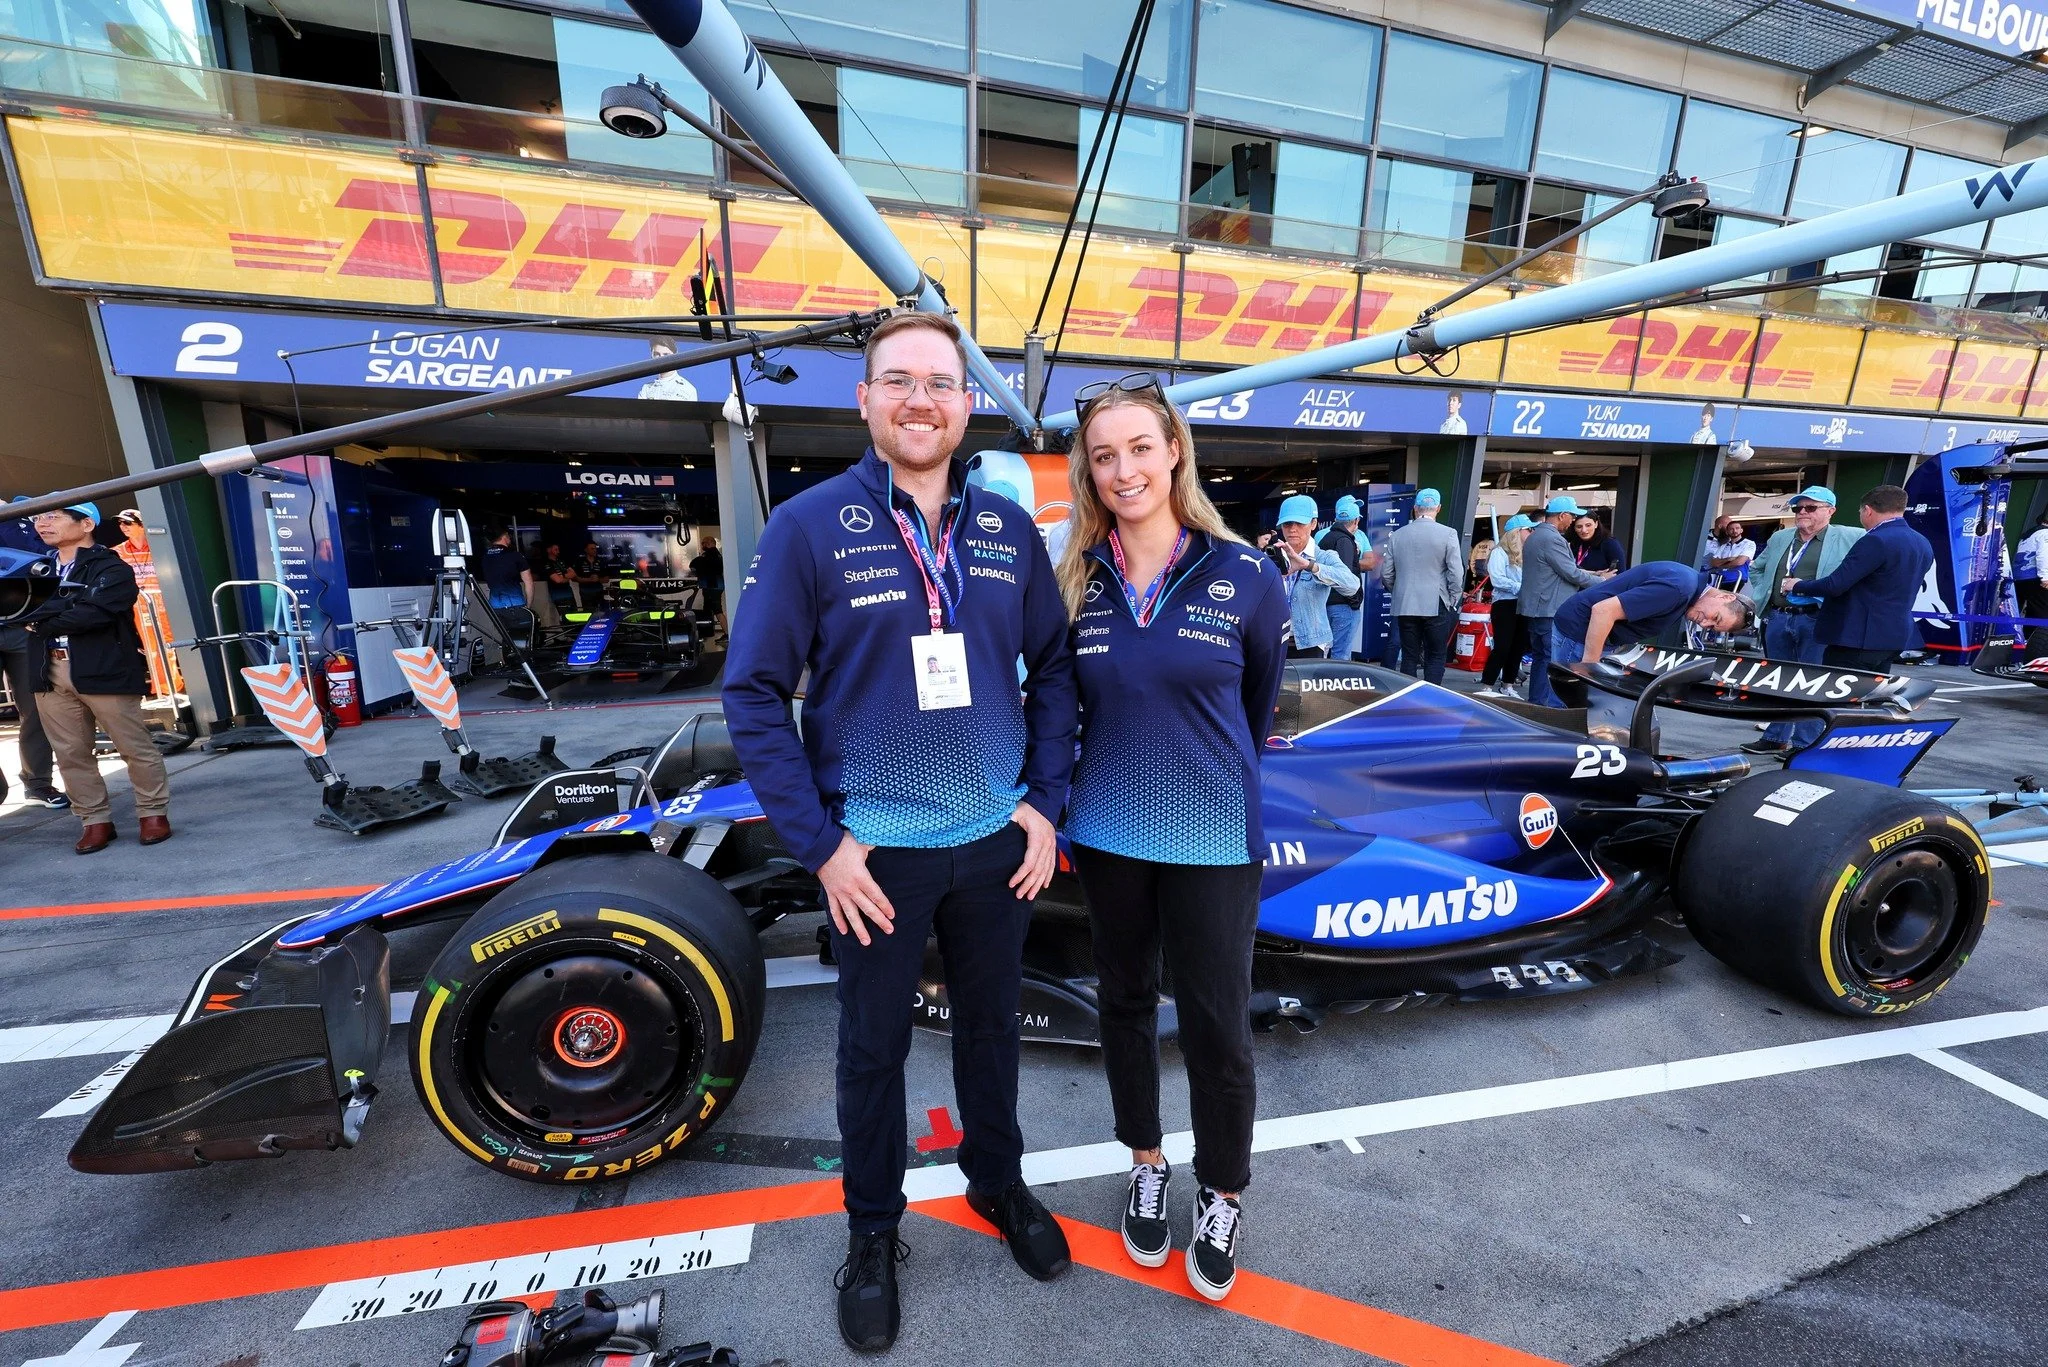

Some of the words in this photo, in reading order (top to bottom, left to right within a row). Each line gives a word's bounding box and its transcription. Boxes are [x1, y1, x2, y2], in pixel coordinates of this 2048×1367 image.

[1916, 0, 2048, 50] MELBOU
[334, 178, 807, 310] DHL
[1120, 267, 1394, 351] DHL
[175, 321, 243, 375] 2
[368, 329, 500, 360] LOGAN
[1597, 318, 1784, 386] DHL
[1186, 389, 1255, 421] 23
[1300, 388, 1355, 407] ALEX
[1294, 408, 1366, 428] ALBON
[1512, 400, 1545, 434] 22
[1586, 404, 1621, 421] YUKI
[1580, 422, 1651, 439] TSUNODA
[1810, 425, 1826, 435] VISA
[1943, 427, 1957, 451] 3
[1986, 429, 2020, 443] DANIEL
[565, 472, 651, 486] LOGAN
[979, 517, 1001, 527] Gulf
[848, 543, 897, 554] MYPROTEIN
[966, 538, 1018, 556] WILLIAMS
[973, 549, 1014, 564] RACING
[844, 565, 899, 584] Stephens
[969, 566, 1016, 584] DURACELL
[850, 589, 907, 608] KOMATSU
[1209, 586, 1233, 596] Gulf
[1081, 609, 1113, 619] MYPROTEIN
[1186, 604, 1241, 625] WILLIAMS
[1189, 614, 1231, 631] RACING
[1078, 626, 1110, 638] Stephens
[1178, 628, 1231, 648] DURACELL
[1301, 677, 1375, 692] DURACELL
[1654, 650, 1861, 699] WLIAMS
[1820, 729, 1933, 749] KOMATSU
[1570, 744, 1627, 779] 23
[555, 795, 595, 804] Ventures
[663, 794, 703, 817] 23
[1522, 811, 1555, 833] Gulf
[1868, 816, 1925, 853] PIRELLI
[1312, 876, 1518, 938] KOMATSU
[470, 909, 562, 963] PIRELLI
[620, 933, 641, 943] TRAVEL
[700, 1091, 717, 1120] P
[563, 1122, 691, 1181] ZERO
[342, 1297, 385, 1322] 30
[401, 1288, 443, 1313] 20
[461, 1279, 498, 1304] 10
[526, 1272, 546, 1293] 0
[572, 1263, 607, 1287] 10
[627, 1256, 661, 1278] 20
[679, 1249, 713, 1269] 30
